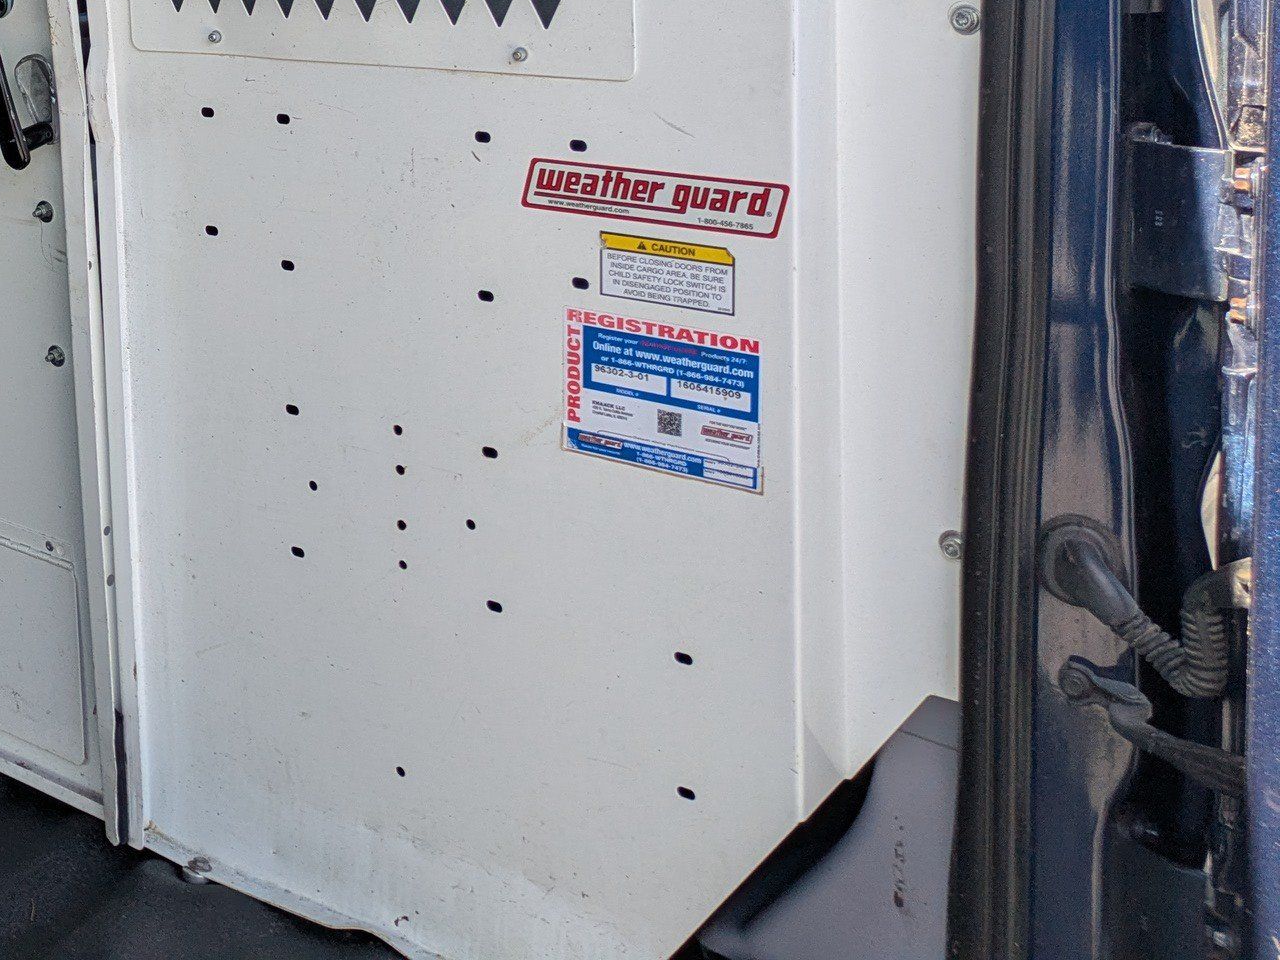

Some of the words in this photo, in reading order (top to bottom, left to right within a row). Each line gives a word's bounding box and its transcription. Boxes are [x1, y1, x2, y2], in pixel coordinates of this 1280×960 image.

[536, 169, 666, 203] weather
[672, 184, 771, 217] guard
[547, 199, 630, 215] www.weatherguard.com
[651, 243, 696, 257] CAUTION
[607, 253, 637, 263] BEFORE
[639, 256, 673, 269] CLOSING
[674, 262, 703, 273] DOORS
[704, 266, 728, 277] FROM
[610, 262, 635, 272] INSIDE
[636, 265, 664, 276] CARGO
[690, 273, 701, 281] BE
[702, 275, 724, 285] SURE
[608, 269, 631, 279] CHILD
[632, 273, 661, 283] SAFETY
[663, 277, 684, 288] LOCK
[685, 281, 717, 292] SWITCH
[718, 285, 726, 294] IS
[613, 279, 620, 287] IN
[621, 280, 671, 295] DISENGAGED
[672, 288, 710, 300] POSITION
[711, 293, 722, 302] TO
[623, 289, 646, 299] AVOID
[647, 292, 671, 303] BEING
[566, 308, 760, 354] REGISTRATION
[597, 332, 623, 344] Register
[592, 340, 622, 355] Online
[623, 347, 634, 357] at
[635, 350, 754, 379] www.weatherguard.com
[567, 324, 581, 423] PRODUCT
[594, 364, 650, 381] 96302-3-01
[677, 380, 742, 400] 1605415909
